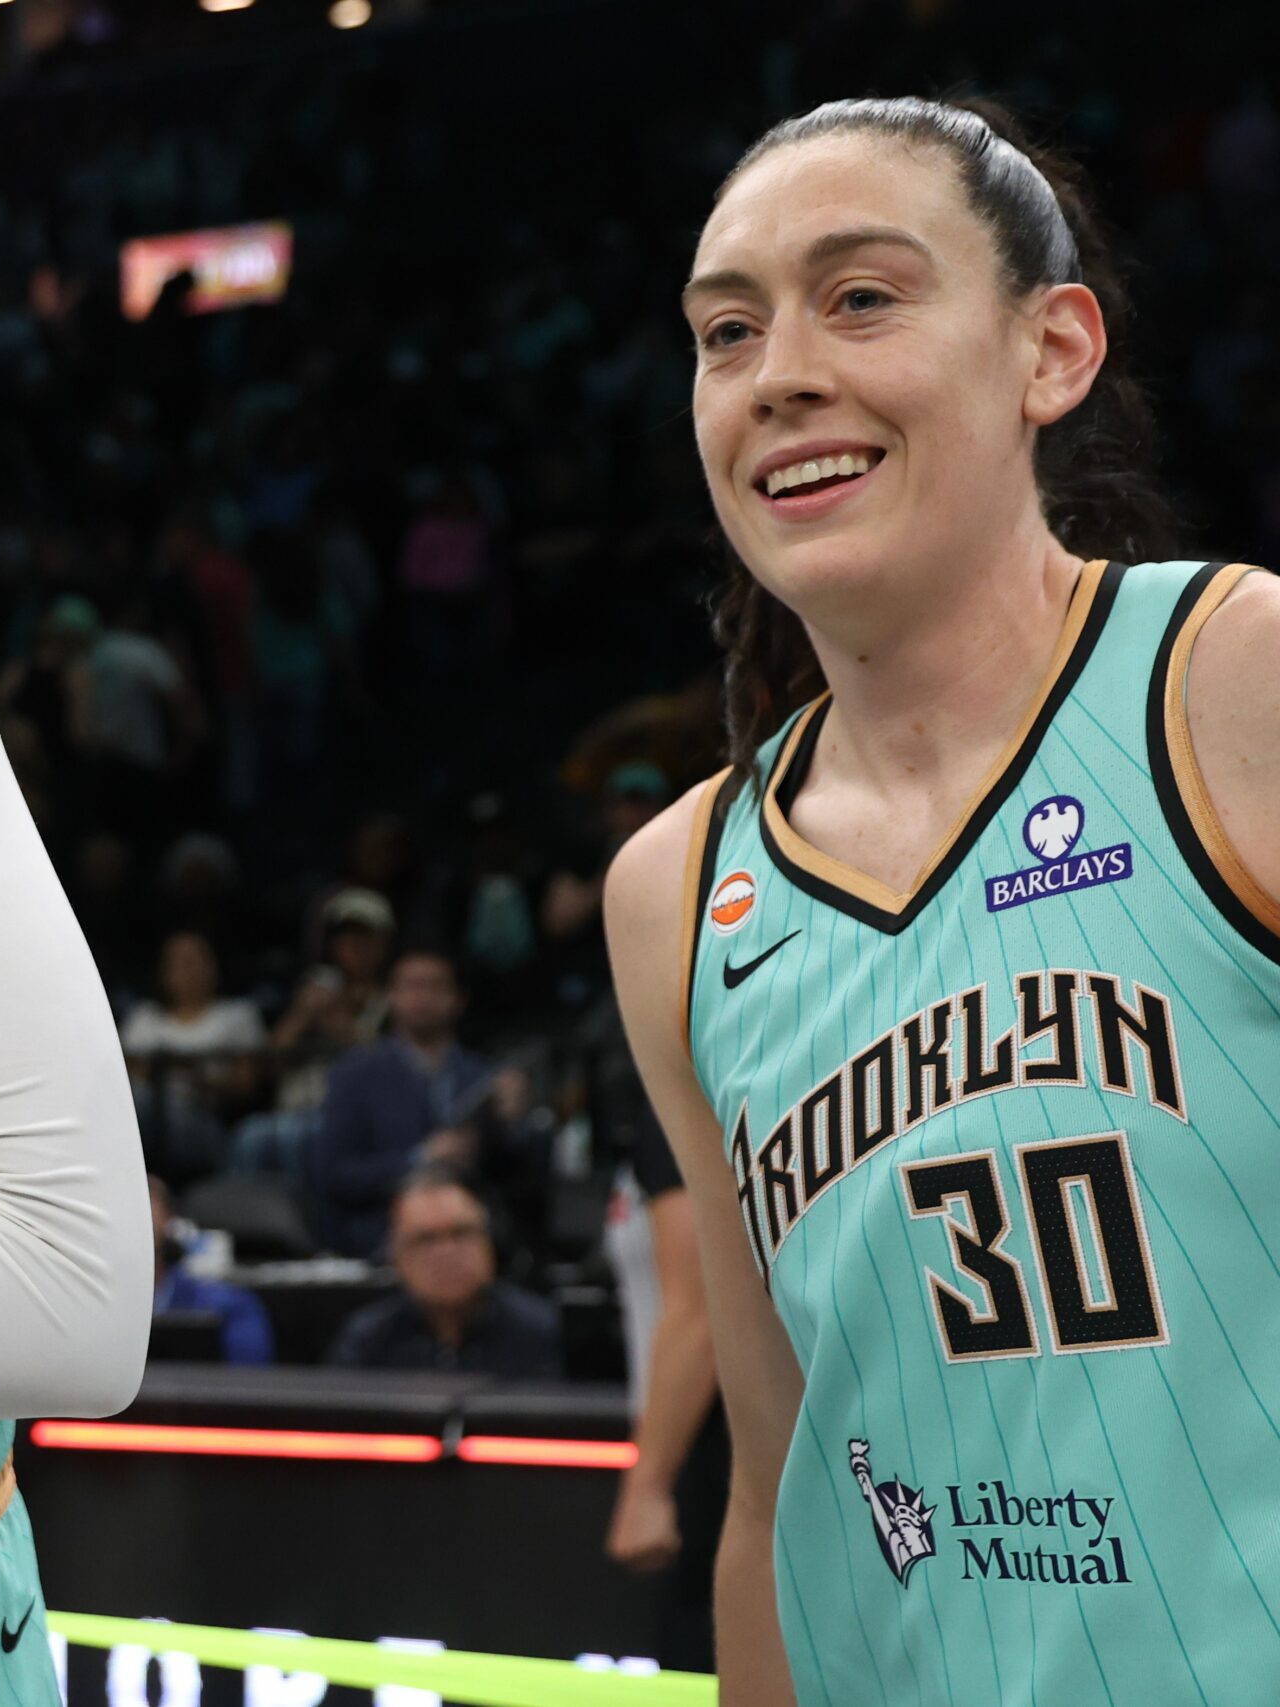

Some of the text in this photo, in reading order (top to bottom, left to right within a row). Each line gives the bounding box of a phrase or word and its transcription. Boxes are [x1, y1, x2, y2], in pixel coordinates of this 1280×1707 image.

[991, 848, 1127, 907] BARCLAYS
[732, 967, 1189, 1296] BROOKLYN
[897, 1129, 1172, 1365] 30
[945, 1480, 1116, 1548] Liberty
[956, 1536, 1133, 1585] Mutual
